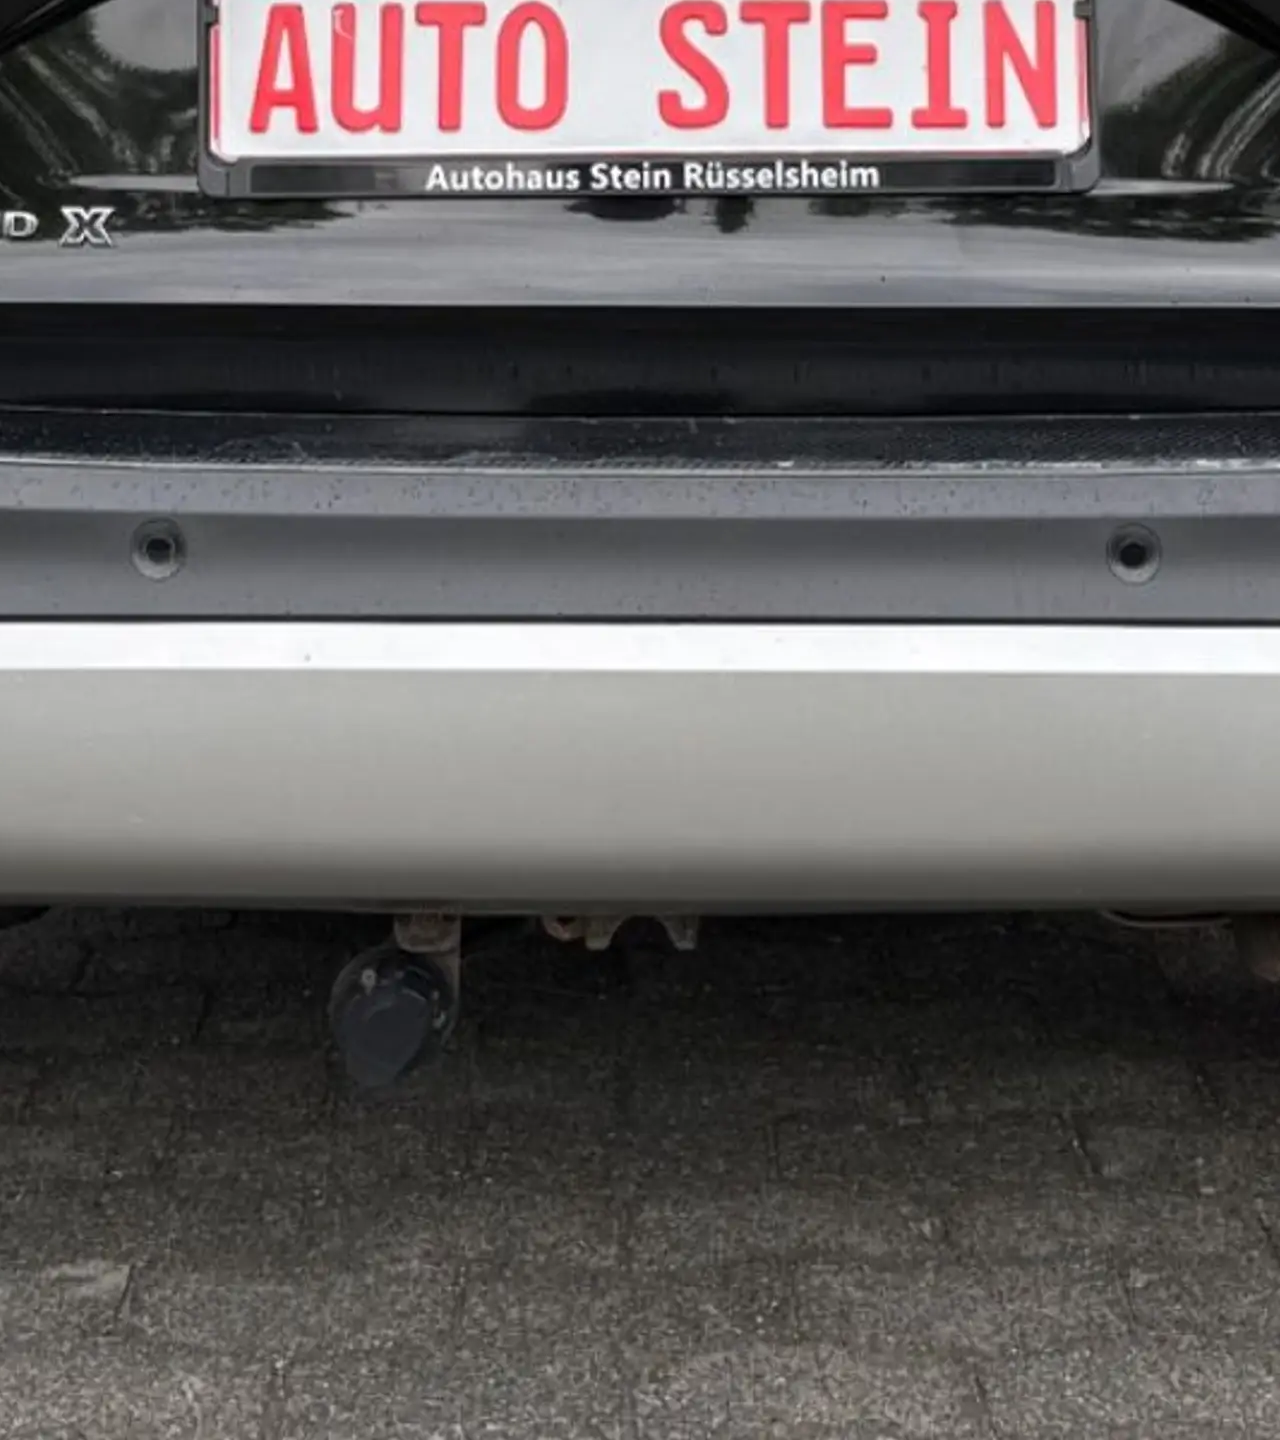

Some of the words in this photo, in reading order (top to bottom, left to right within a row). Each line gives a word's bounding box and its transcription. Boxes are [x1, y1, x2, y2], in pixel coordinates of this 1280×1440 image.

[250, 0, 569, 134] AUTO
[426, 163, 580, 191] Autohaus
[589, 162, 672, 190] Stein
[683, 160, 880, 189] Rüsselsheim
[60, 206, 115, 246] X
